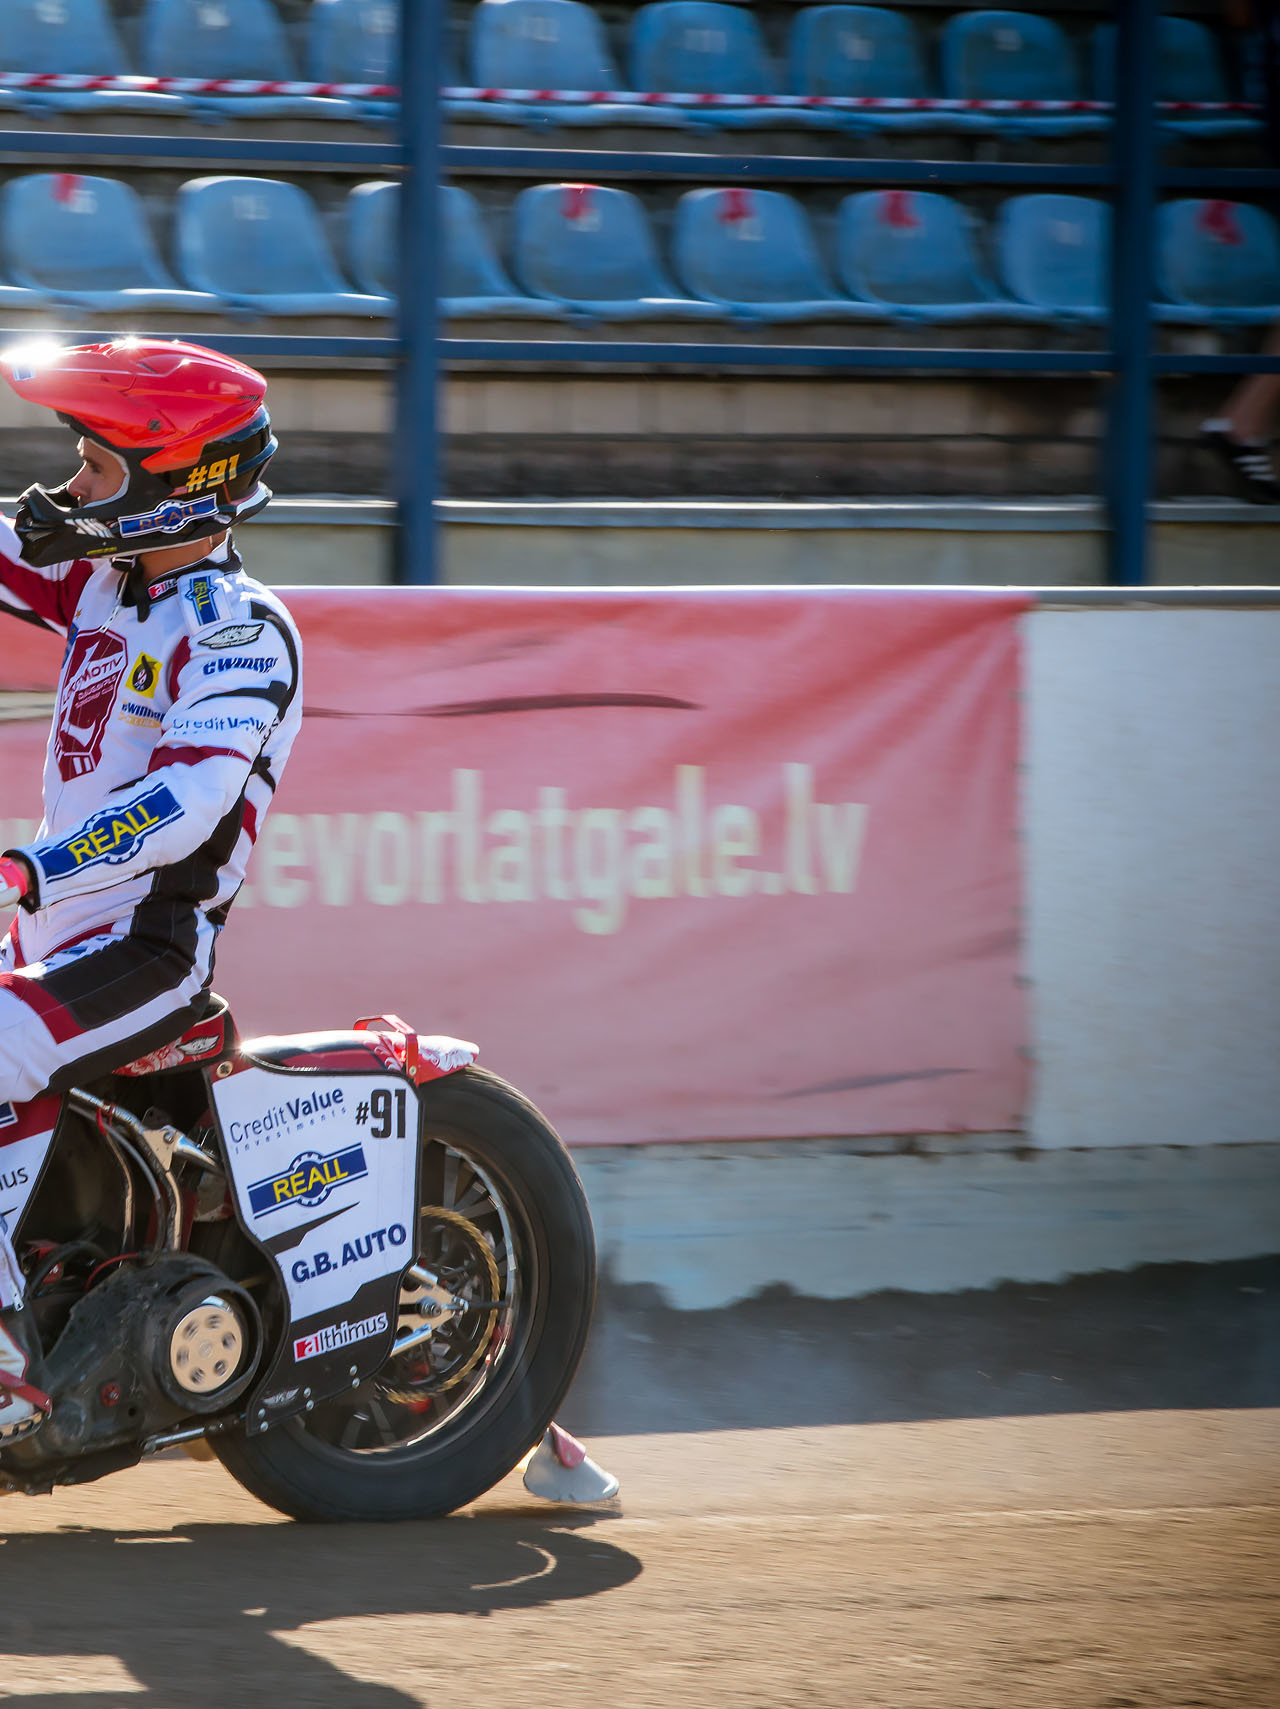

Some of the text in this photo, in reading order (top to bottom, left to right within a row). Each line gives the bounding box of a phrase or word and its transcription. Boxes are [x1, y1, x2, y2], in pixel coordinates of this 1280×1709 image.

[186, 453, 240, 493] #91
[67, 803, 160, 865] REALL
[355, 1088, 407, 1139] #91
[273, 1158, 349, 1203] REALL
[291, 1223, 407, 1283] G.B. AUTO
[295, 1313, 388, 1360] althimus
